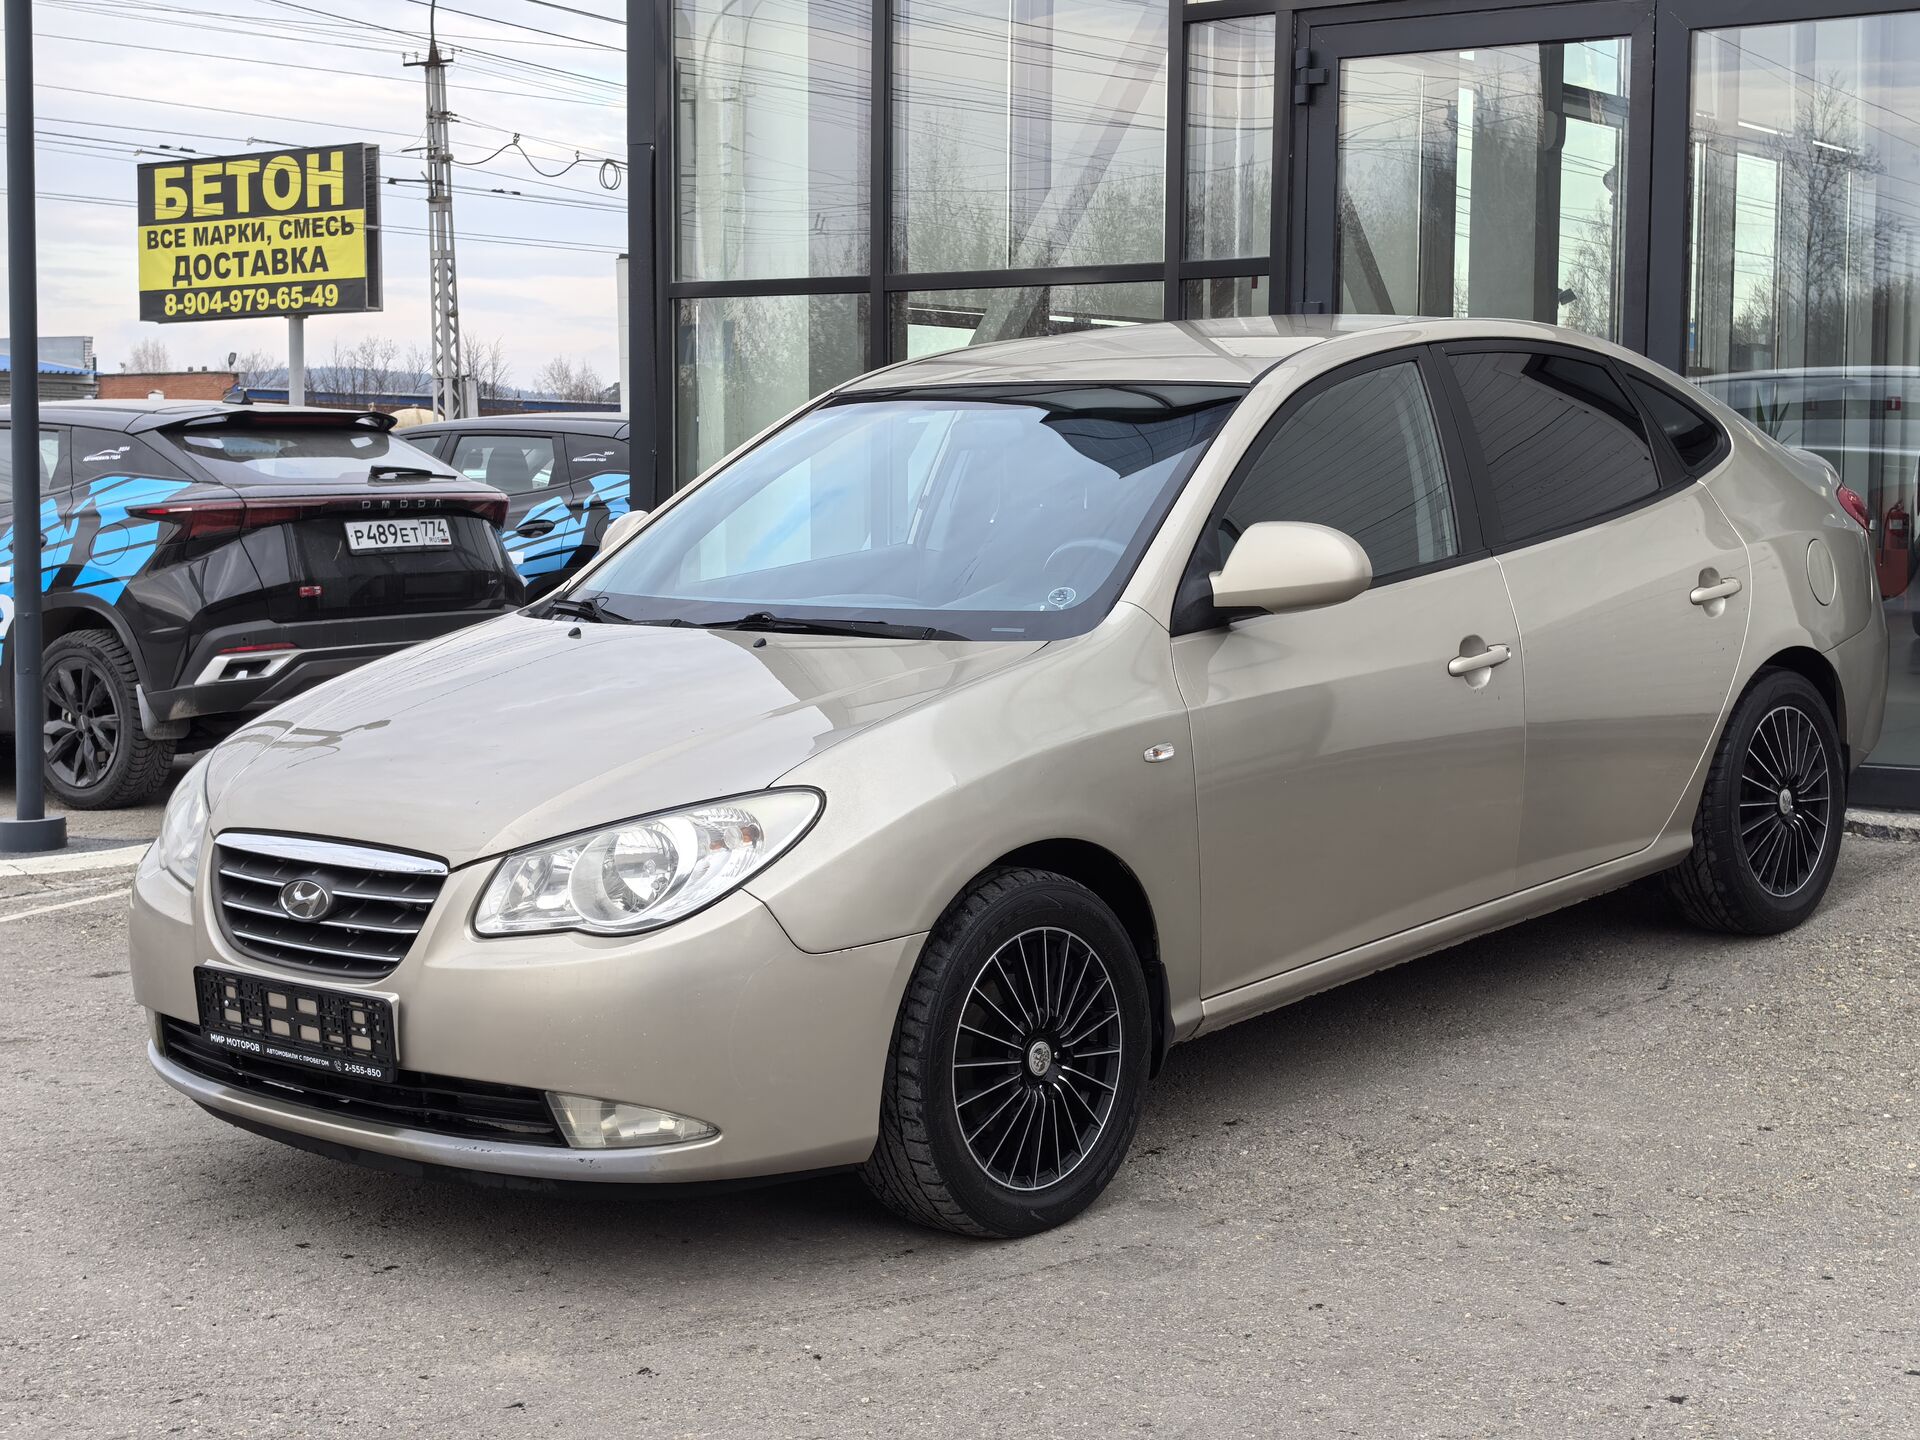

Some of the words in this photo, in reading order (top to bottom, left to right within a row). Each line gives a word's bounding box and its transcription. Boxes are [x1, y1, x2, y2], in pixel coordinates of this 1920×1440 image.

[154, 151, 344, 220] БЕТОН
[146, 228, 186, 250] ВСЕ
[193, 221, 272, 246] МАРКИ,
[279, 215, 355, 241] СМЕСЬ
[172, 245, 330, 288] ДОСТАВКА
[164, 283, 340, 316] 8-904-979-65-49
[420, 520, 446, 537] 774
[209, 1033, 225, 1044] МИР
[226, 1037, 261, 1052] МОТОРОВ
[266, 1047, 298, 1060] АВТОМОБИЛИ
[303, 1055, 330, 1067] ПРОБЕГОМ
[344, 1063, 382, 1078] 2-555-850
